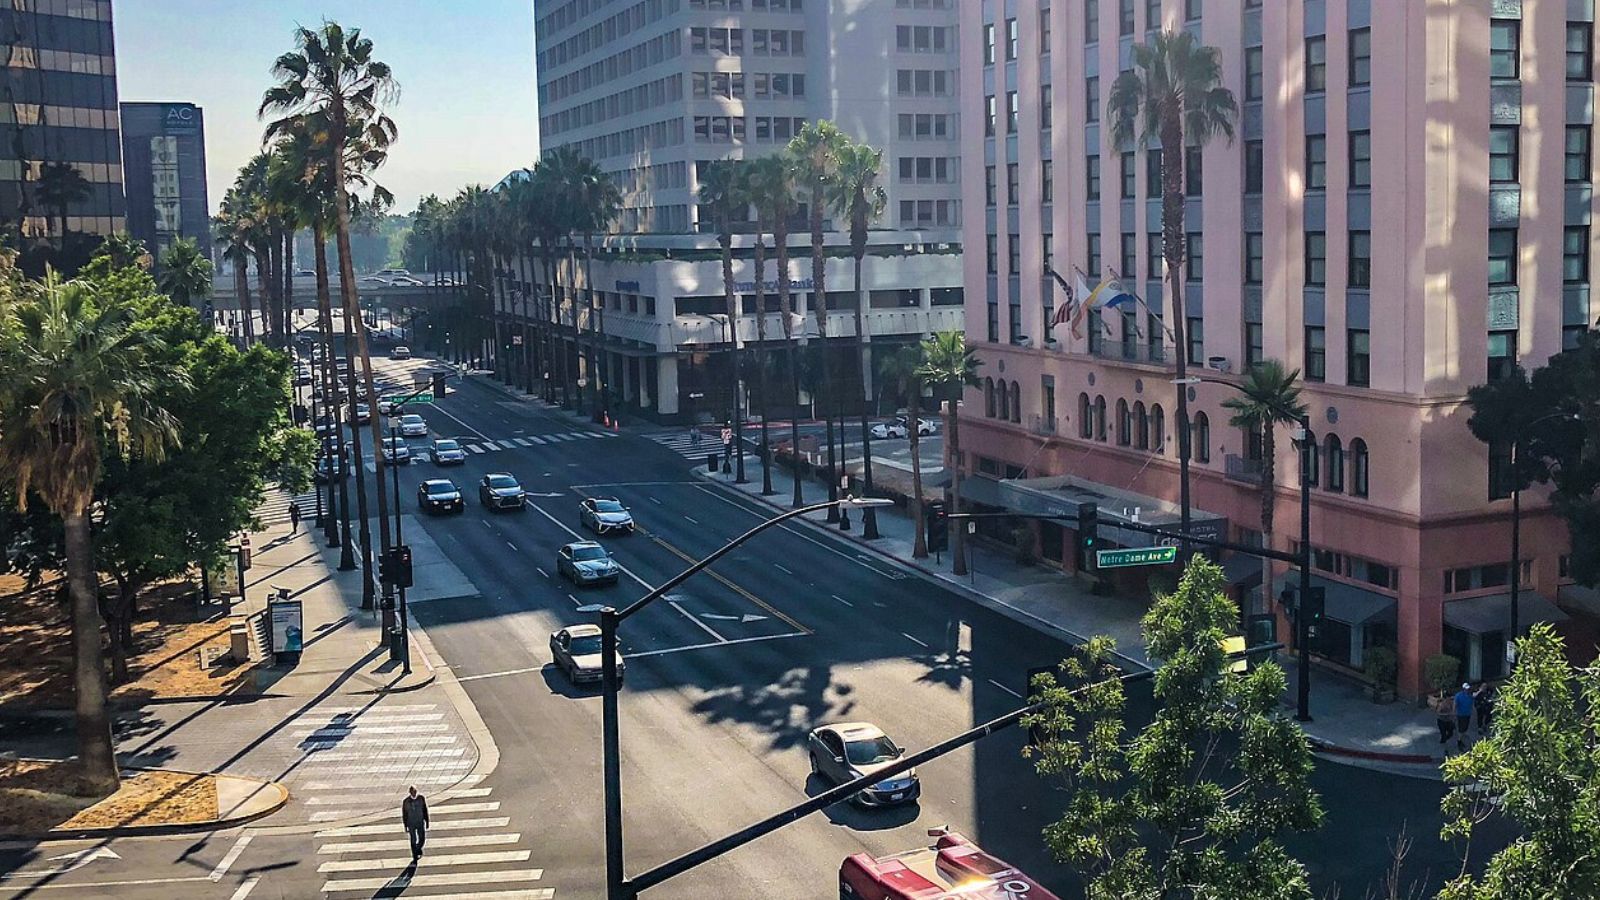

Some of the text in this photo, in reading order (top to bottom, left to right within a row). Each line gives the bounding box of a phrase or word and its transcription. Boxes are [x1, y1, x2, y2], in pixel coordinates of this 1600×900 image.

[168, 107, 193, 120] AC
[1101, 552, 1161, 564] Notre Dame Ave
